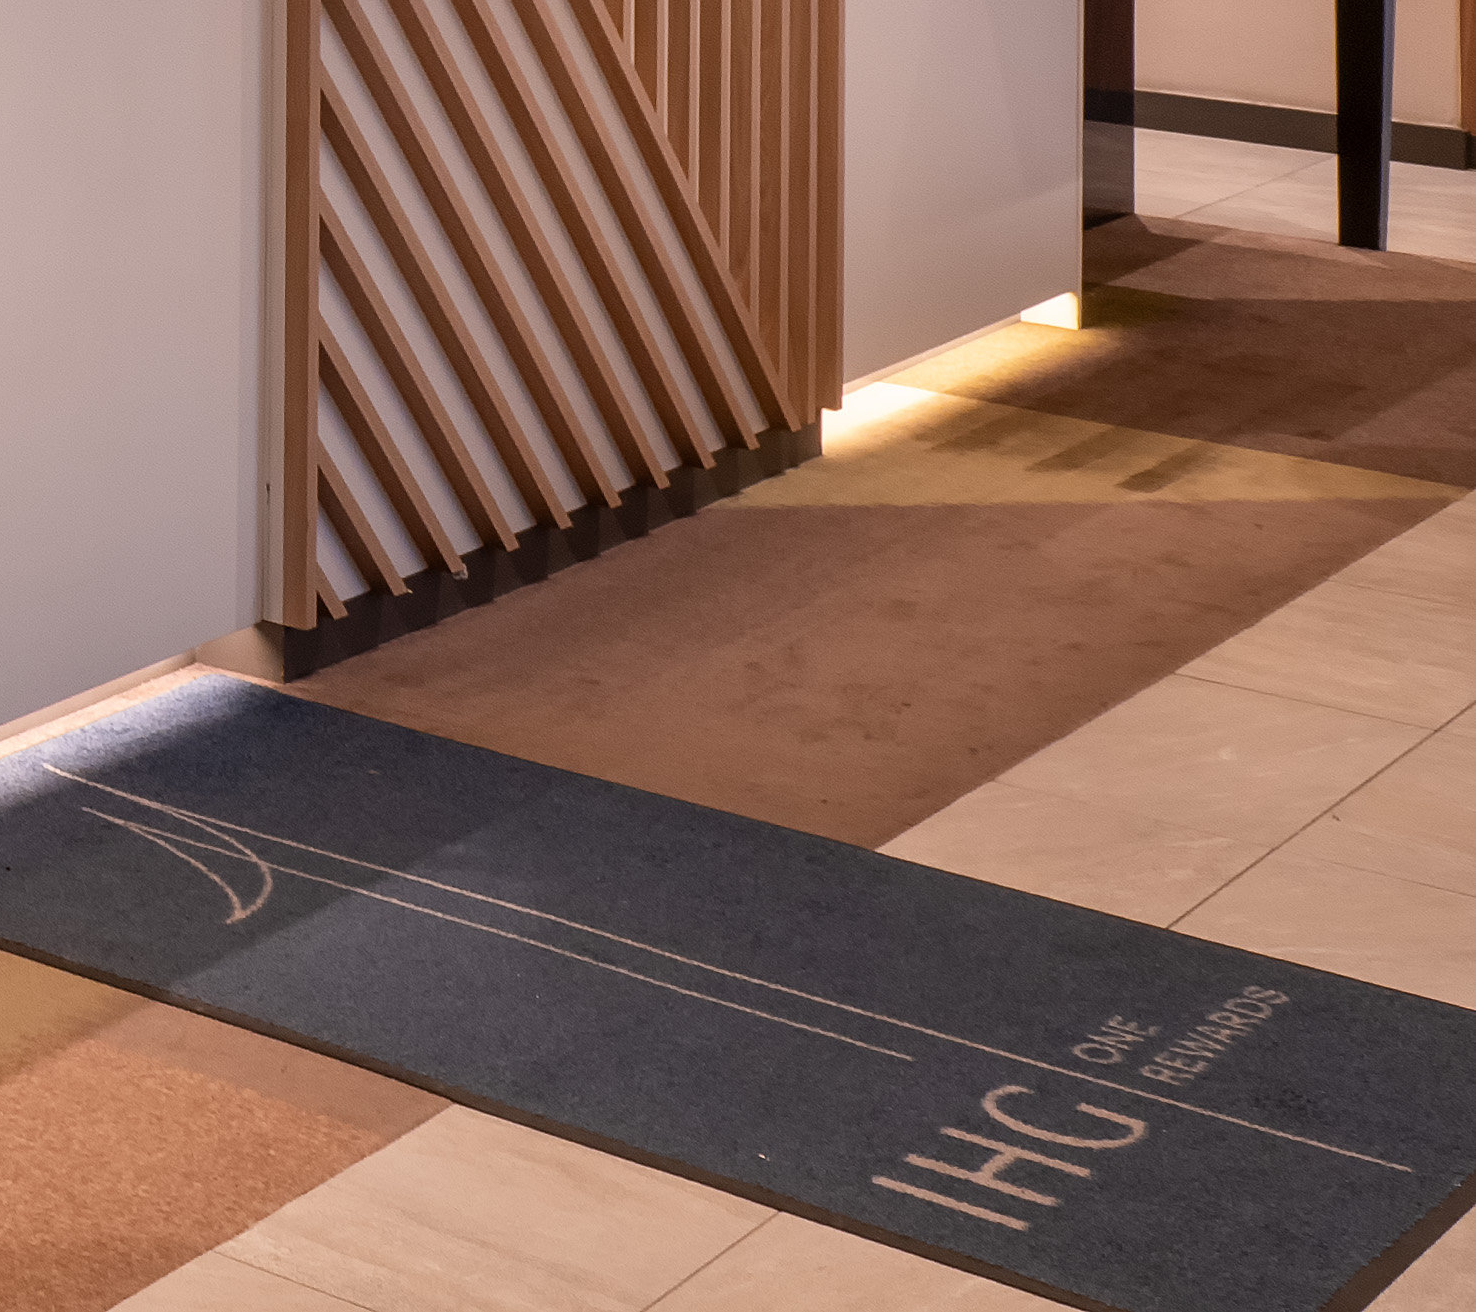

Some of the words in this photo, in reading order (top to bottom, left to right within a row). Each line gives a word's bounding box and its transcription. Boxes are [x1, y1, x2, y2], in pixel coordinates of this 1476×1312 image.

[1072, 1015, 1164, 1066] ONE
[1140, 985, 1290, 1088] REWARDS
[872, 1085, 1148, 1231] IHG
